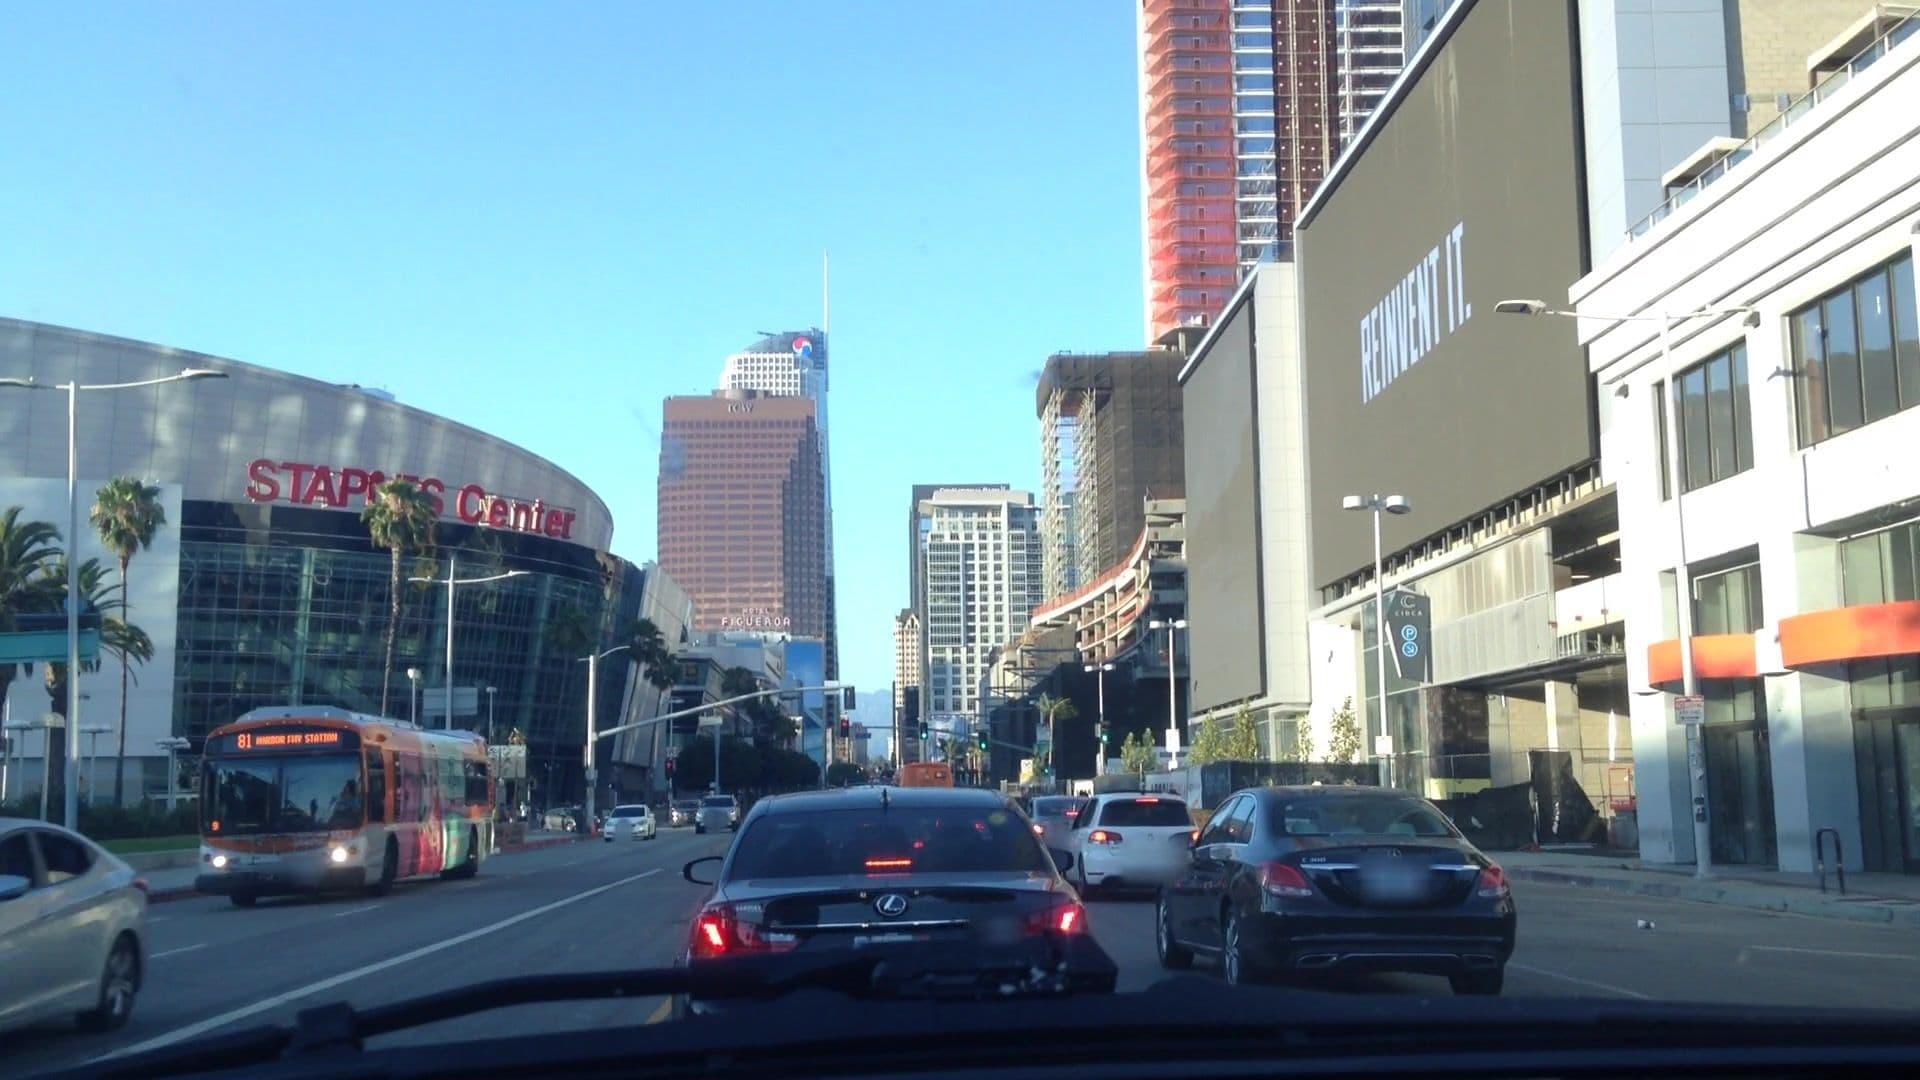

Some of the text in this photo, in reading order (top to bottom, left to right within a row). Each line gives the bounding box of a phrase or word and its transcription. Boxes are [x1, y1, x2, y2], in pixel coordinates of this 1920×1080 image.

[1361, 222, 1471, 404] REINVENT IT.
[247, 459, 576, 539] STAPS Center
[237, 733, 252, 748] 81
[304, 732, 338, 744] STATION
